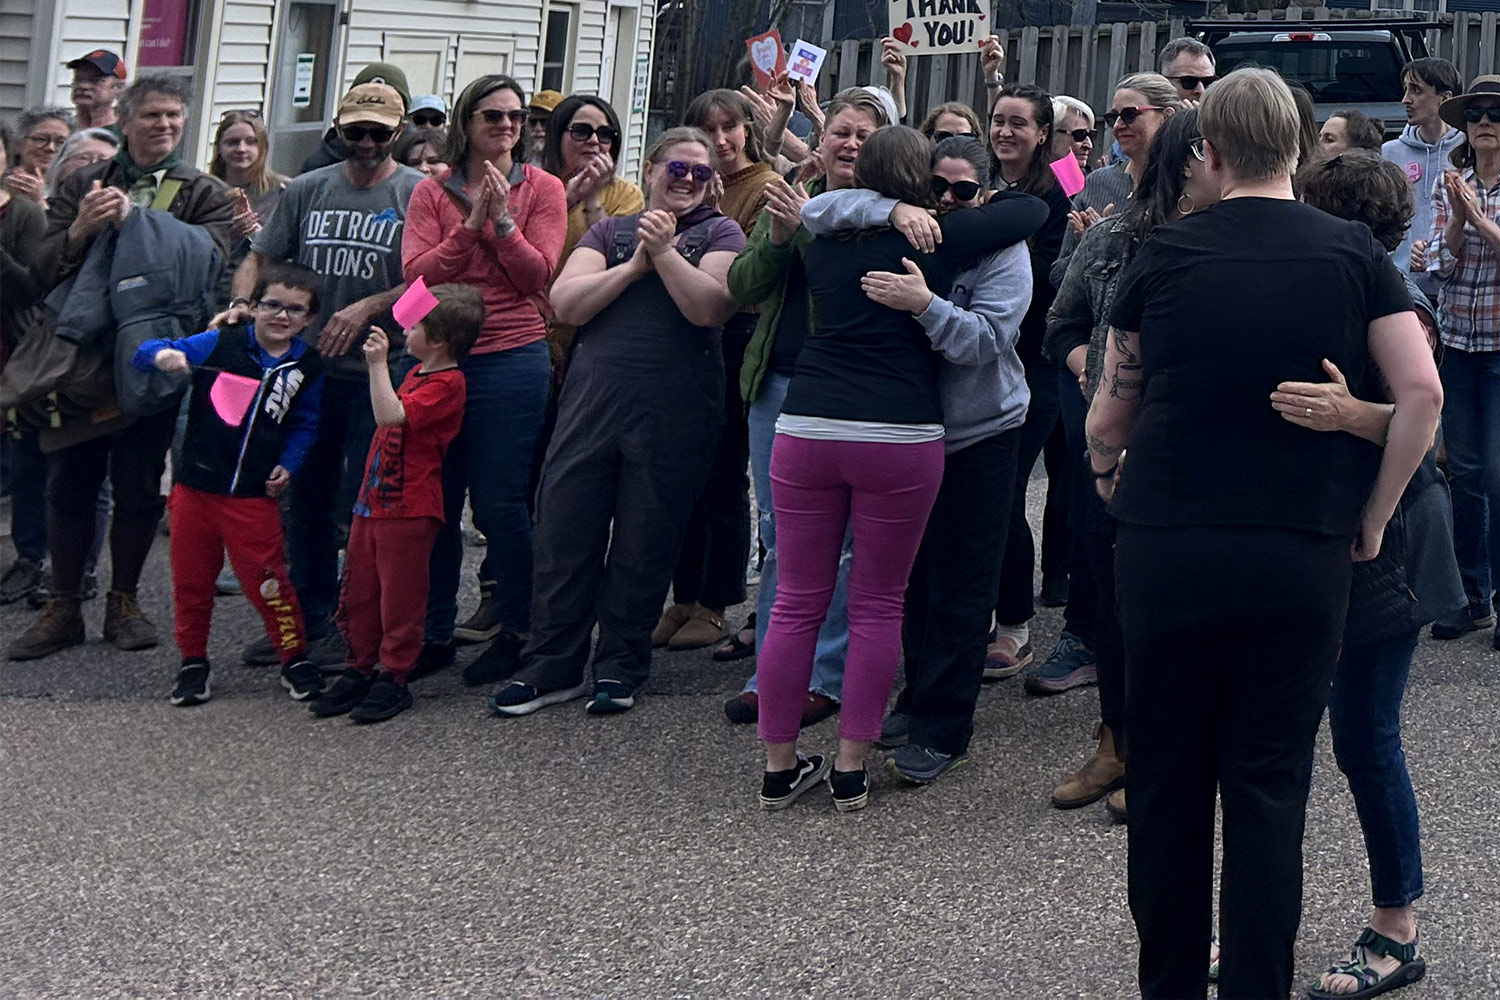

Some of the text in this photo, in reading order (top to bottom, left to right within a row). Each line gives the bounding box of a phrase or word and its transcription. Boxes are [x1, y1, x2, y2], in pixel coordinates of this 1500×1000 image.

[924, 20, 974, 47] YOU!
[307, 209, 403, 246] DETROIT
[311, 246, 378, 280] LIONS
